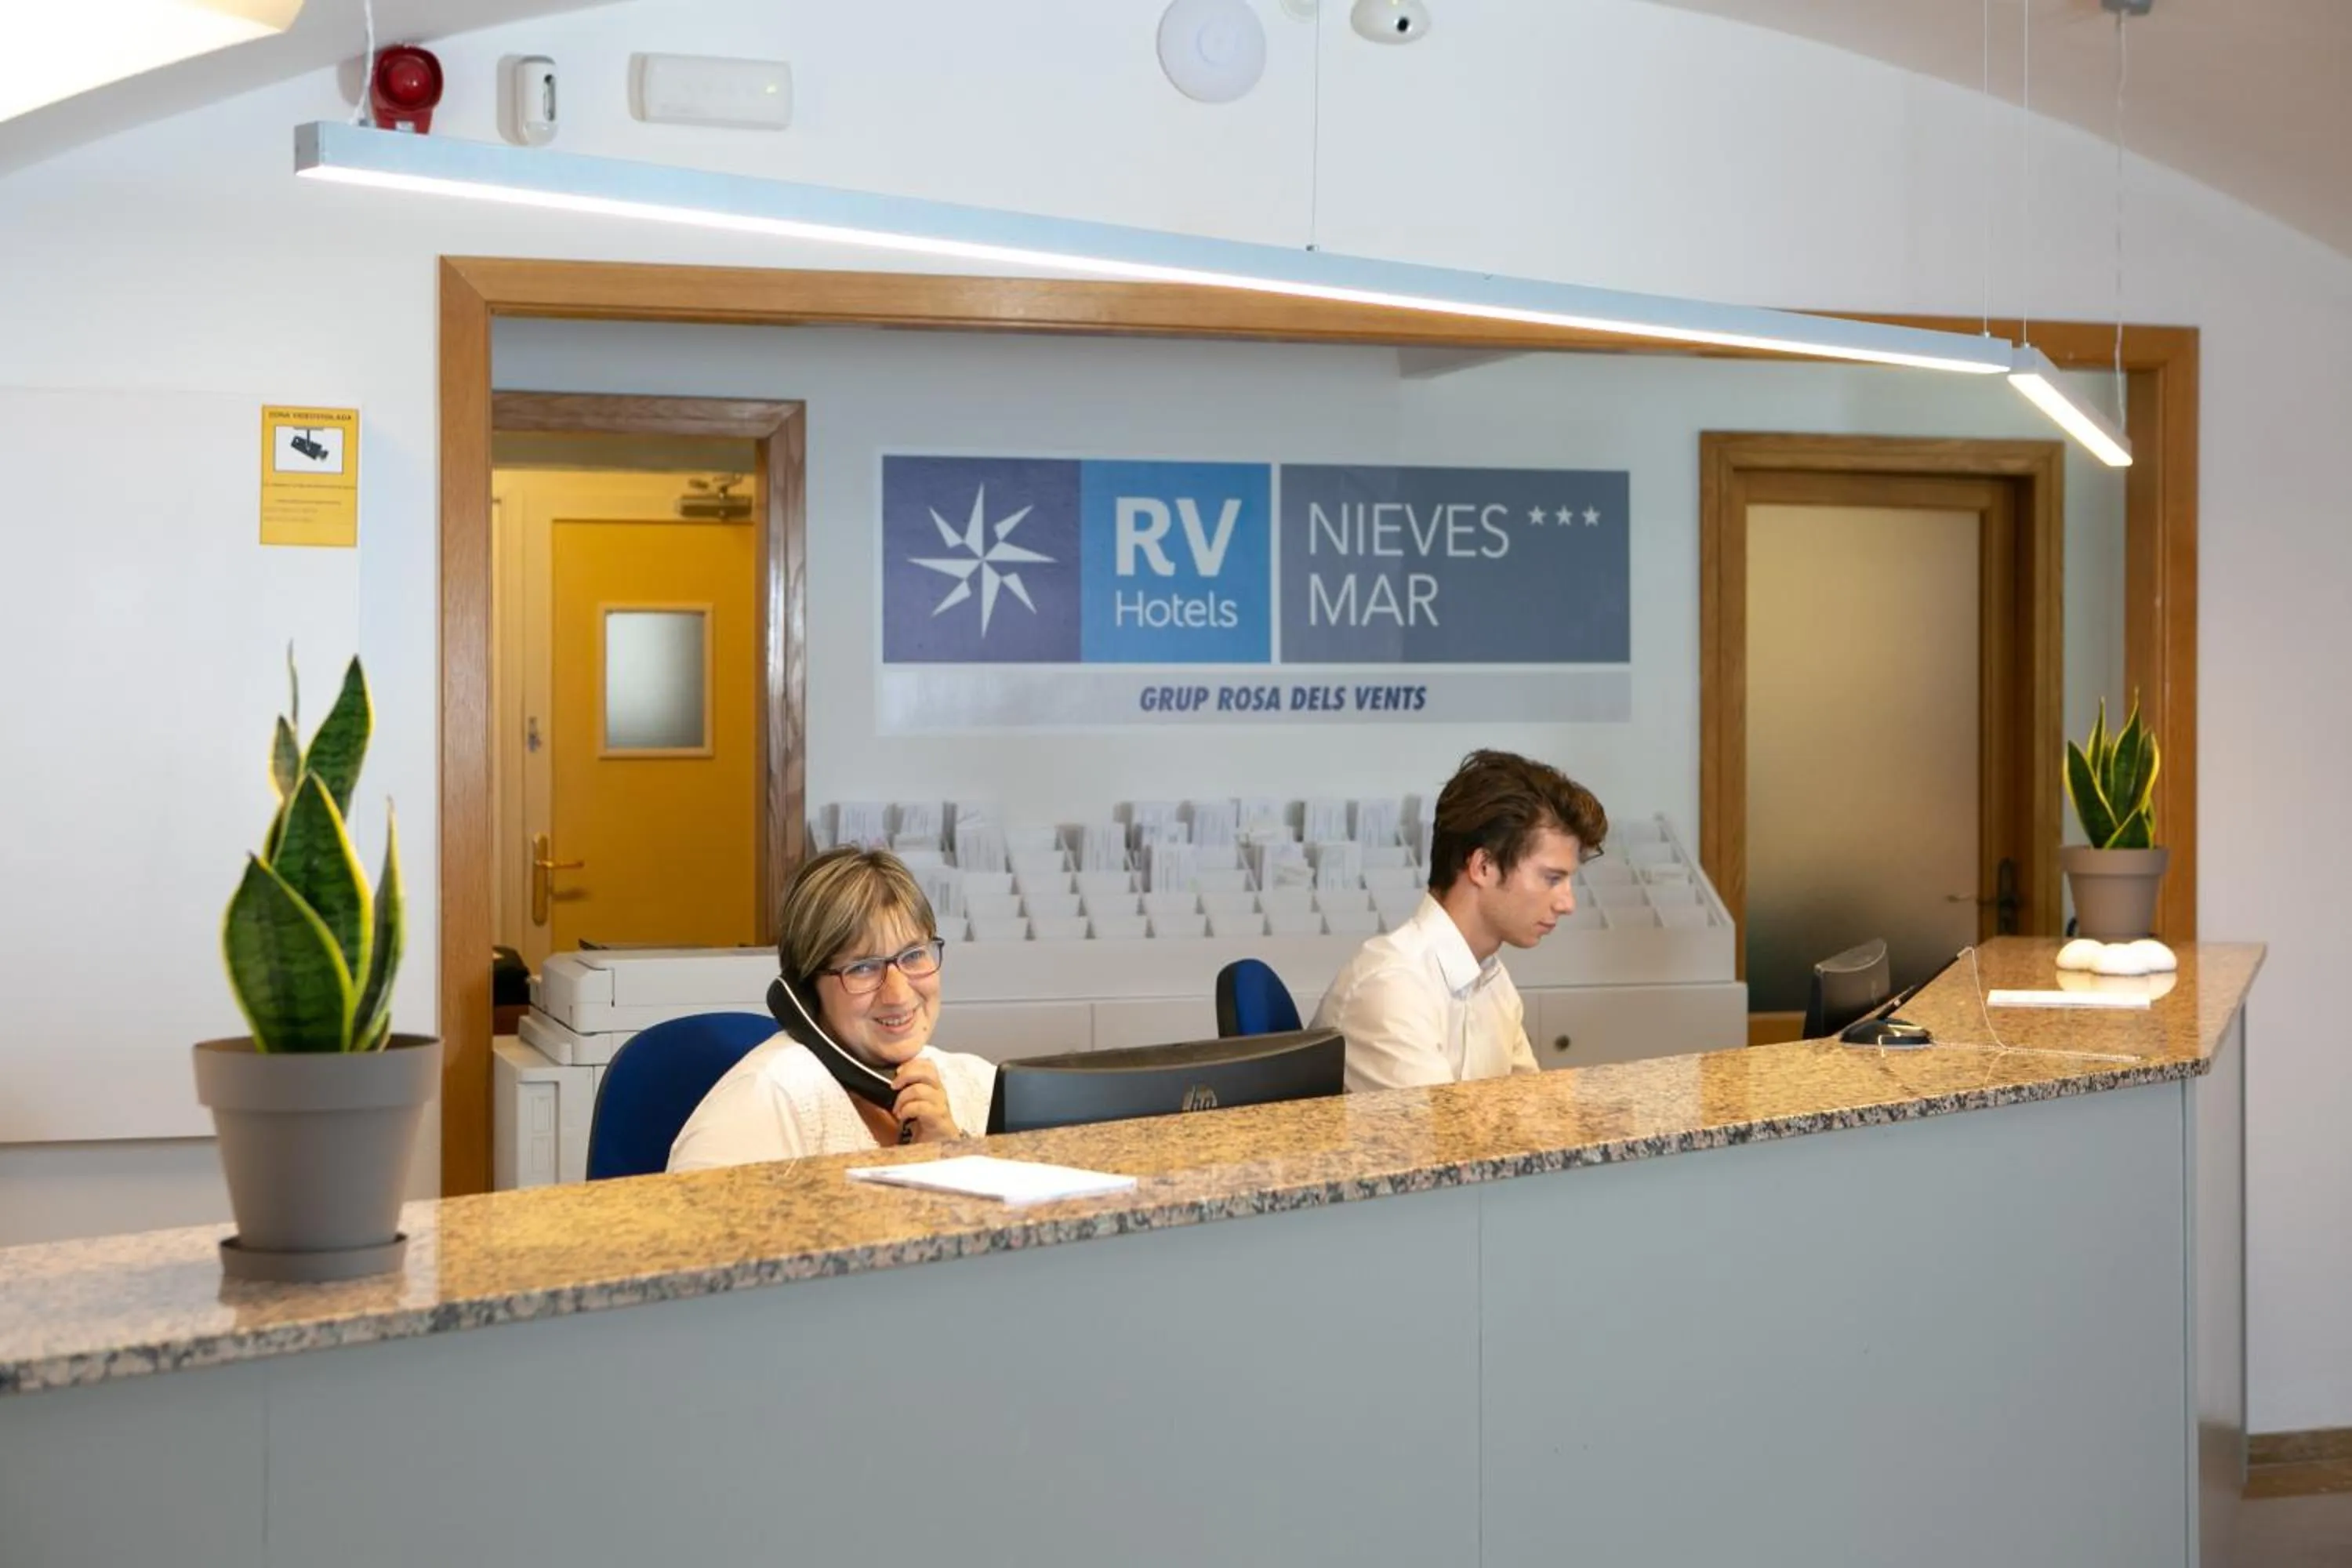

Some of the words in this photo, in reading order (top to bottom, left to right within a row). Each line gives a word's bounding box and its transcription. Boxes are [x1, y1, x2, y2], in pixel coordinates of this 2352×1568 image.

[1116, 496, 1243, 577] RV
[1308, 502, 1510, 558] NIEVES
[1115, 590, 1239, 628] Hotels
[1308, 573, 1439, 627] MAR
[1139, 686, 1210, 712] GRUP
[1217, 686, 1281, 711] ROSA
[1290, 686, 1347, 711] DELS
[1355, 685, 1428, 710] VENTS
